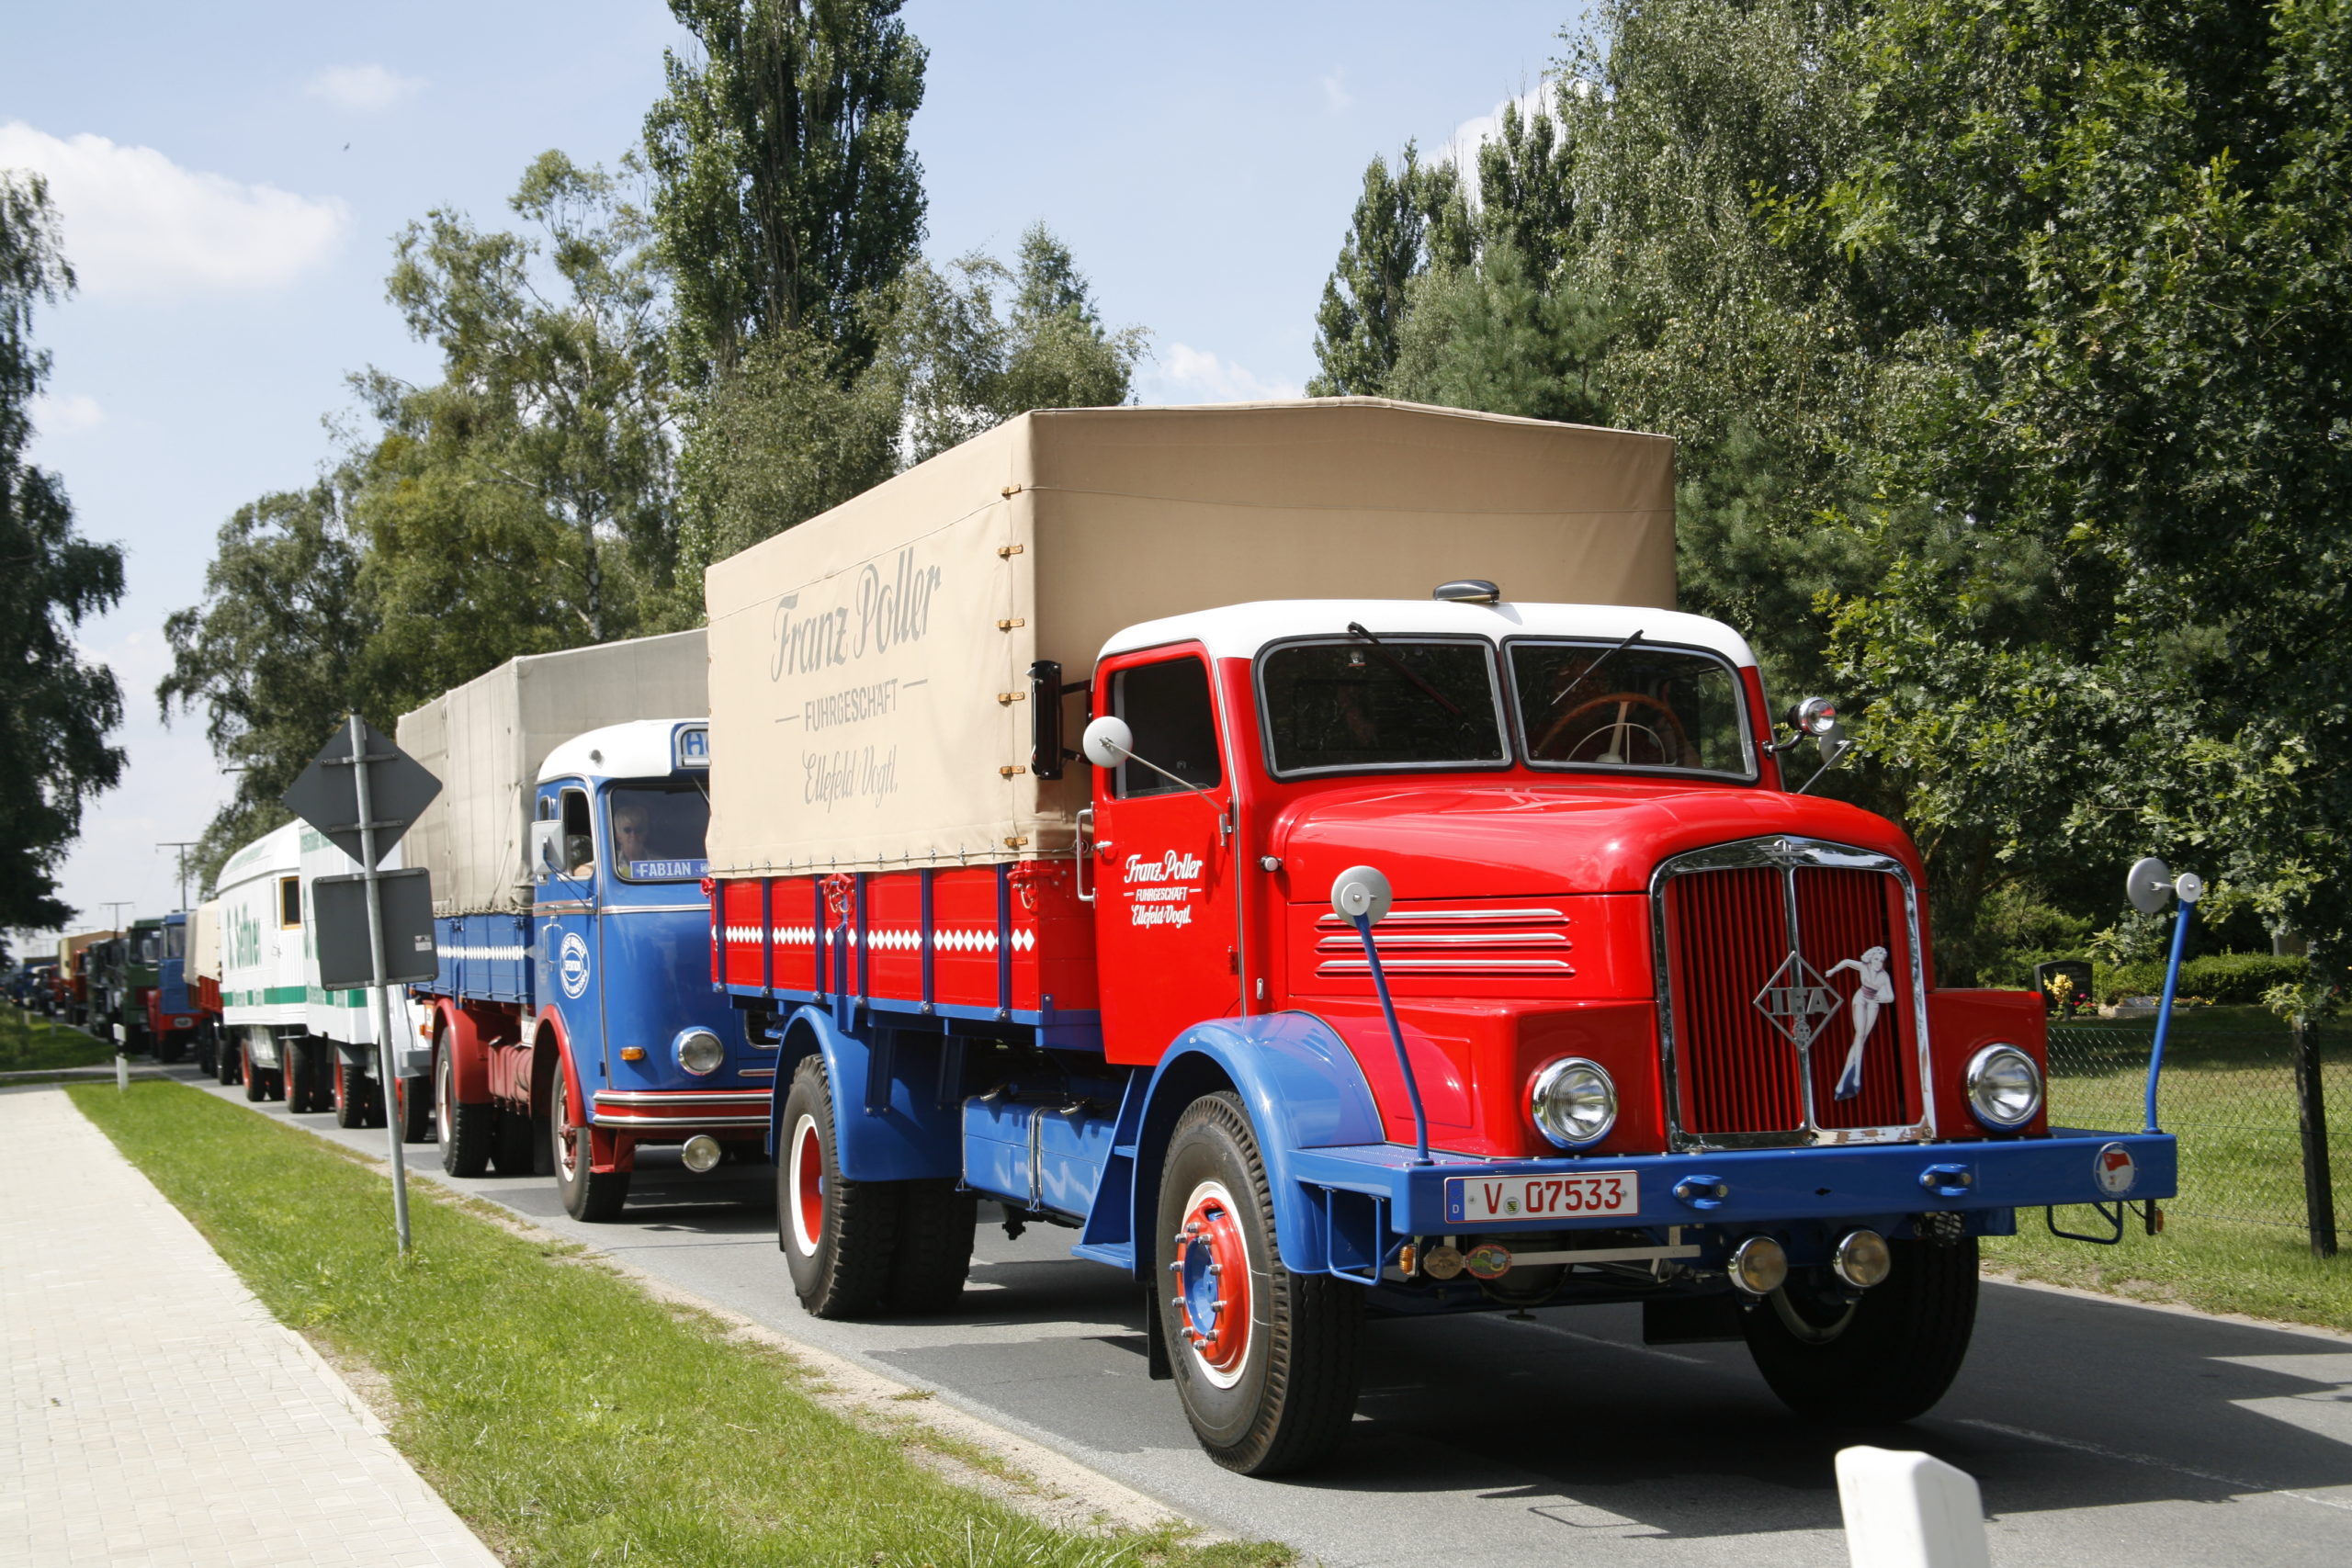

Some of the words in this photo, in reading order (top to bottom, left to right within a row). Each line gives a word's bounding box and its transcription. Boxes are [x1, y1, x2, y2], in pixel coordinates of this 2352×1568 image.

[771, 592, 849, 682] Franz
[854, 546, 942, 660] Poller
[805, 678, 899, 732] FUHRGESCHÄFT
[639, 862, 692, 877] FABIAN
[1124, 853, 1162, 884] Franz
[1160, 849, 1203, 881] Poller
[1769, 987, 1831, 1015] IFA
[1452, 1203, 1460, 1214] D
[1484, 1182, 1503, 1214] V
[1525, 1178, 1622, 1213] 07533
